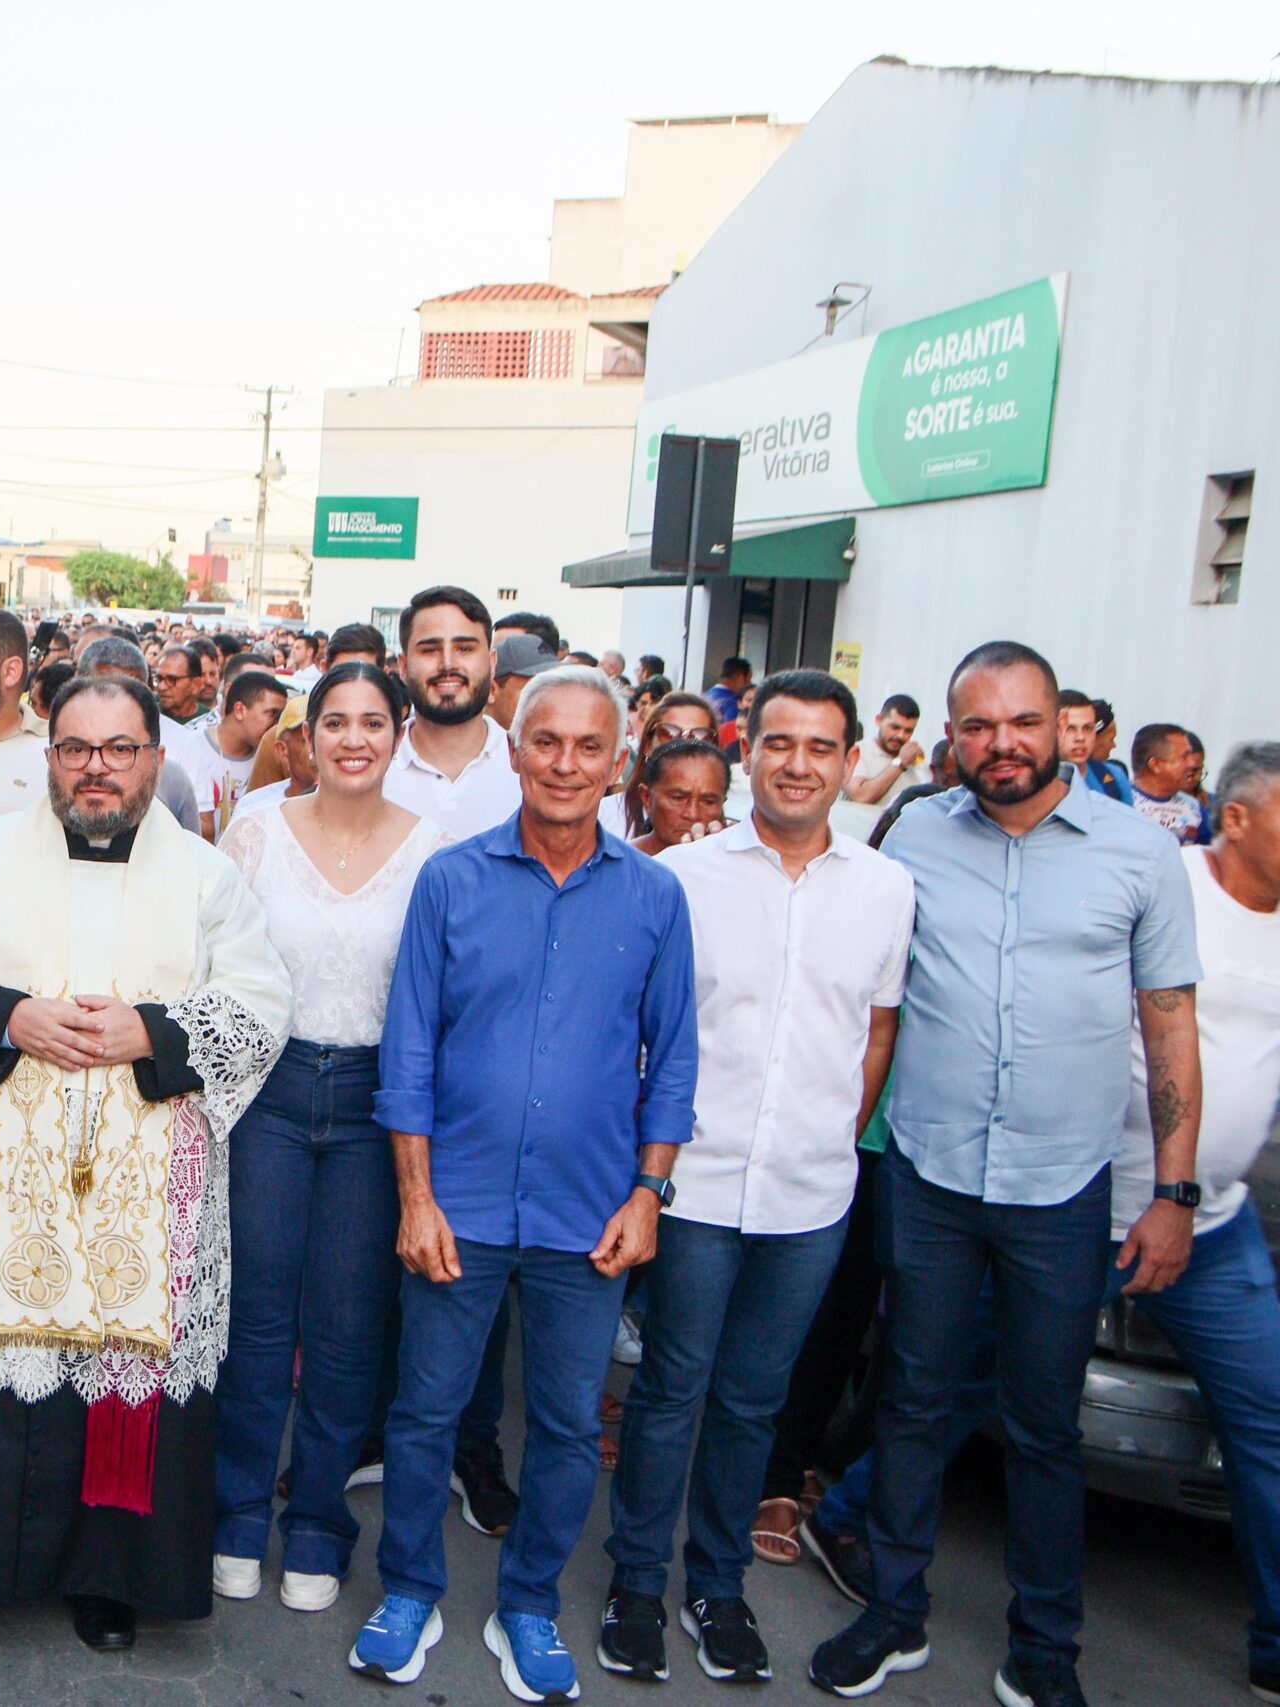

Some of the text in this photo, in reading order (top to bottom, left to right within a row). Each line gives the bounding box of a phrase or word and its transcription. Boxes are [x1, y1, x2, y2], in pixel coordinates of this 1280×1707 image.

[913, 311, 1026, 375] GARANTIA
[931, 359, 1008, 398] é nossa, a
[904, 395, 1018, 441] SORTE é sua.
[763, 448, 831, 481] Vitória
